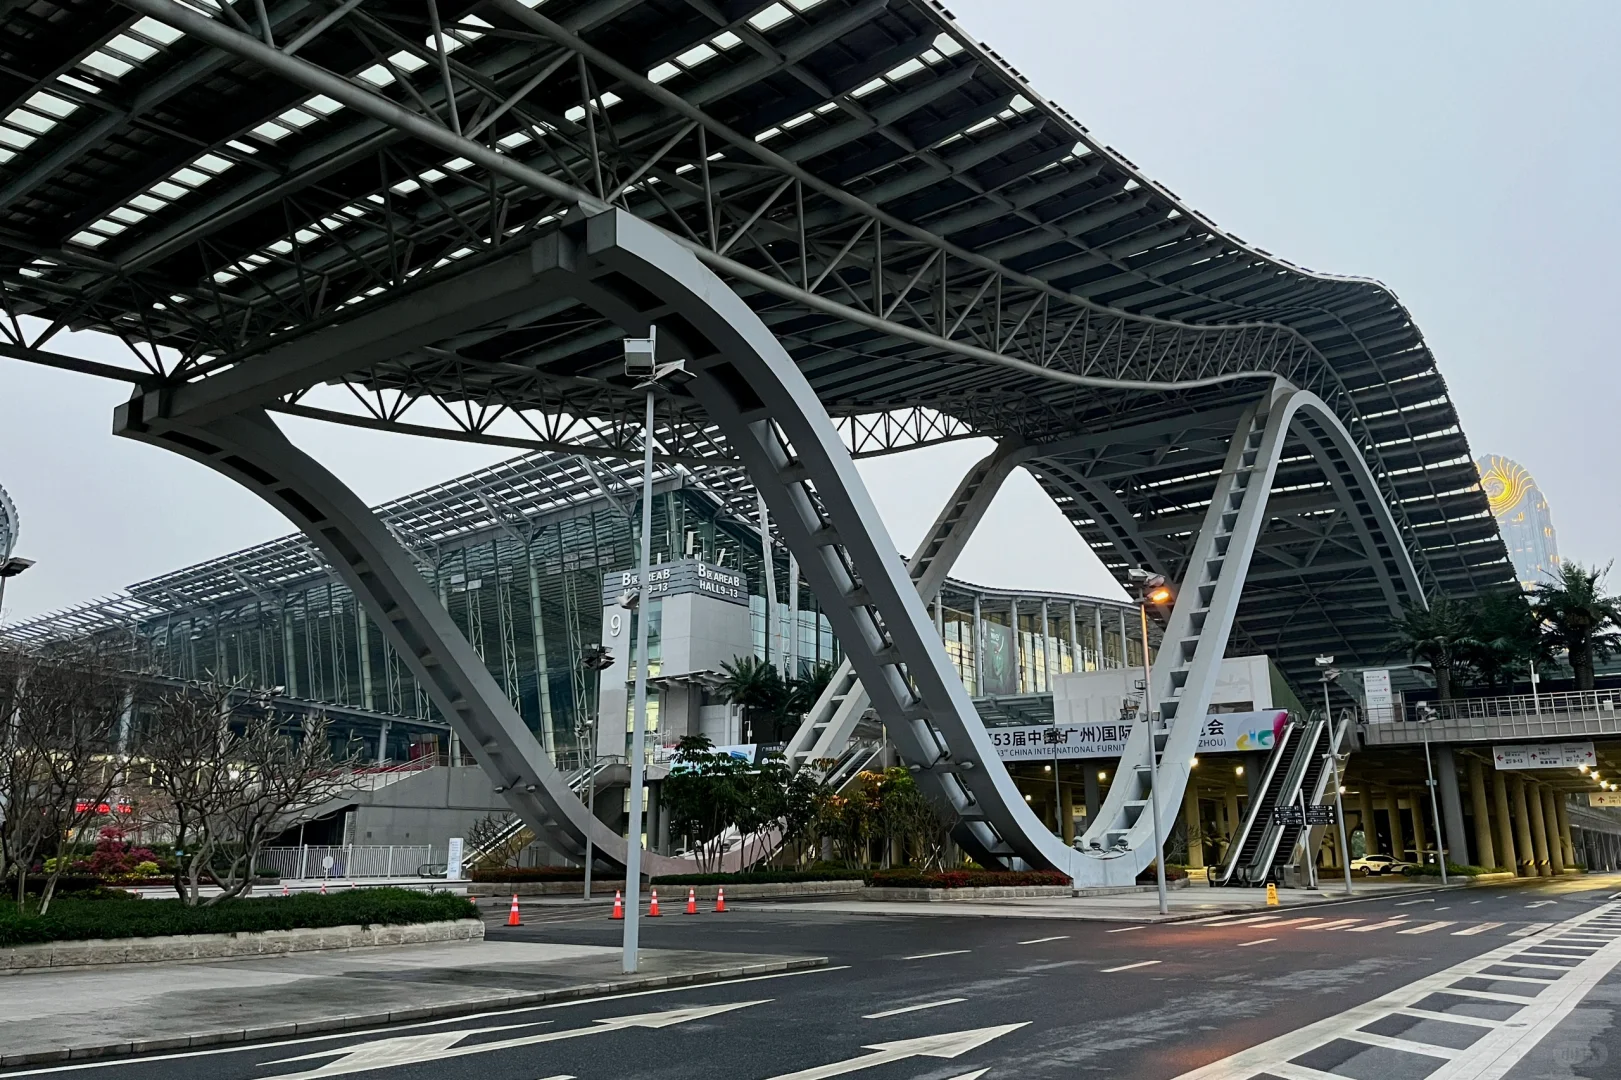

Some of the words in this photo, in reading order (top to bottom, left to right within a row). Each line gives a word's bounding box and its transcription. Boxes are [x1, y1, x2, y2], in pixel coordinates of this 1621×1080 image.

[663, 568, 671, 580] B
[713, 574, 733, 585] AREA
[733, 576, 740, 587] B
[699, 579, 721, 593] HALL
[720, 586, 738, 599] 9-13
[610, 614, 622, 637] 9
[1009, 748, 1033, 757] CHINA
[1034, 744, 1096, 756] INTERNATIONAL
[1097, 742, 1126, 753] FURNIT
[1198, 738, 1227, 748] ZHOU)
